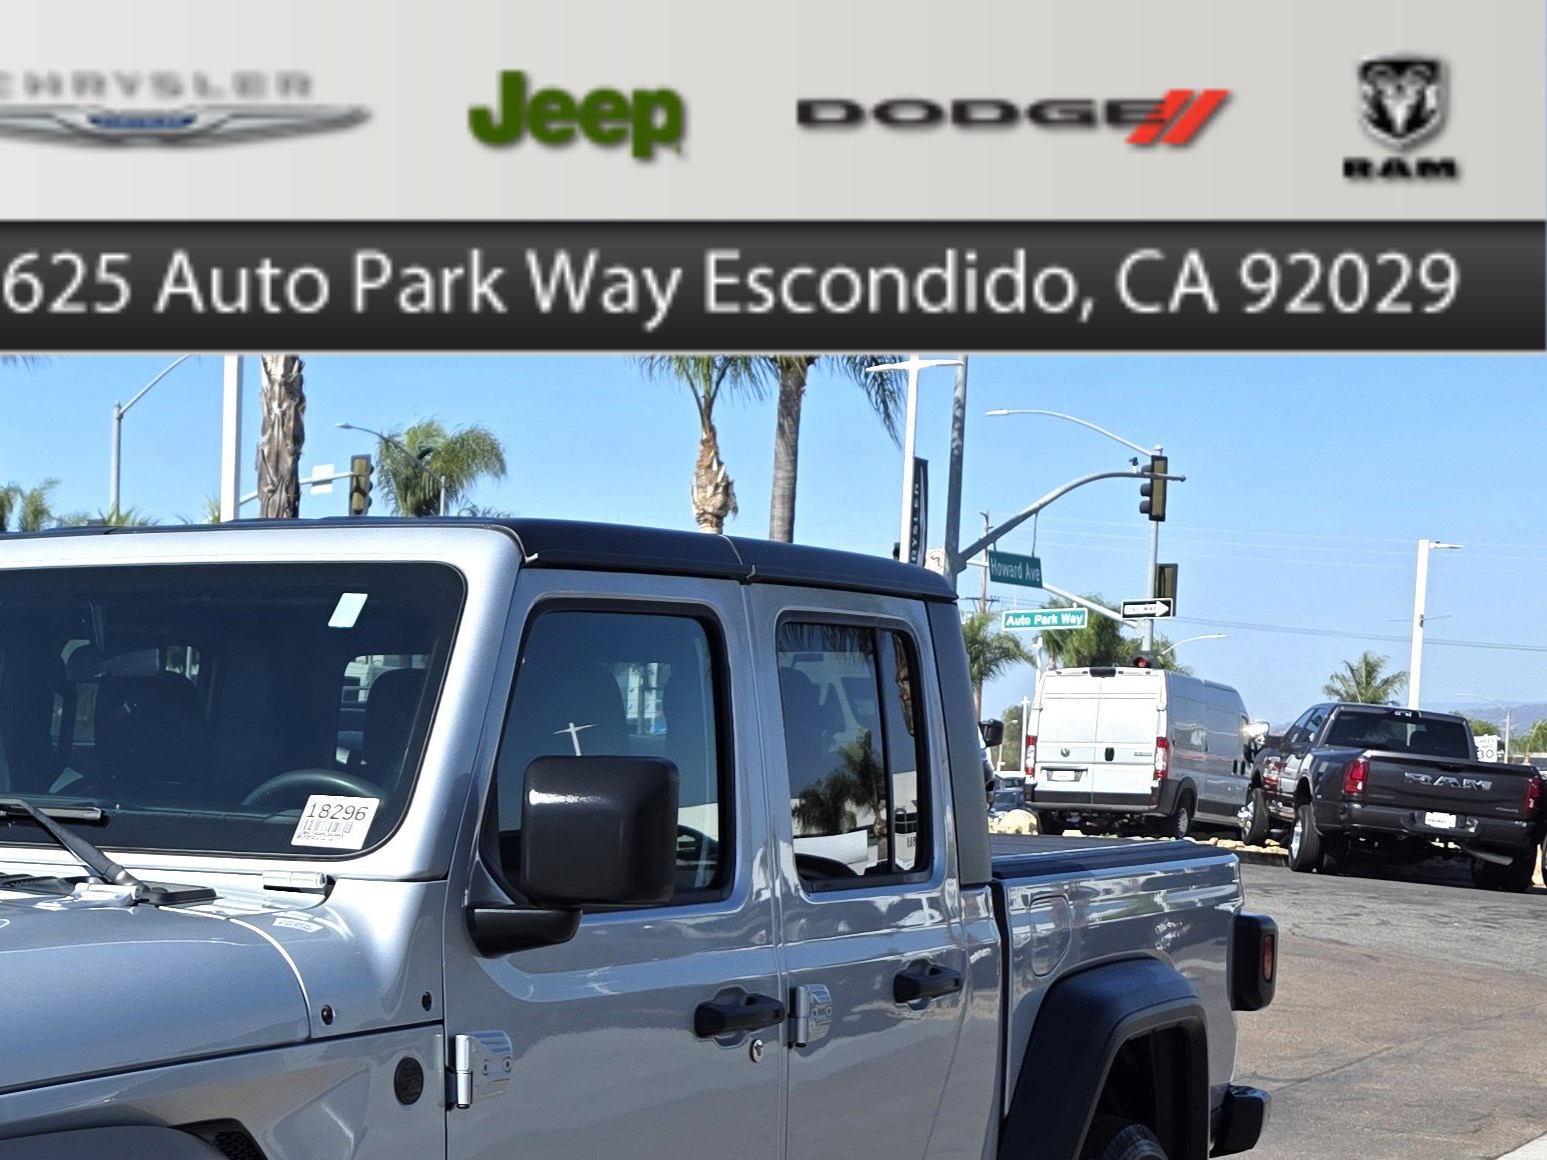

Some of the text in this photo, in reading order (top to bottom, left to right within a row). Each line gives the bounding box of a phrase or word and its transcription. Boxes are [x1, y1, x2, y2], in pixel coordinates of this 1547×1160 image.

[990, 557, 1041, 582] Howard Ave
[1006, 612, 1084, 627] Auto Park Way
[1405, 772, 1493, 790] RAM
[306, 803, 369, 821] 18296
